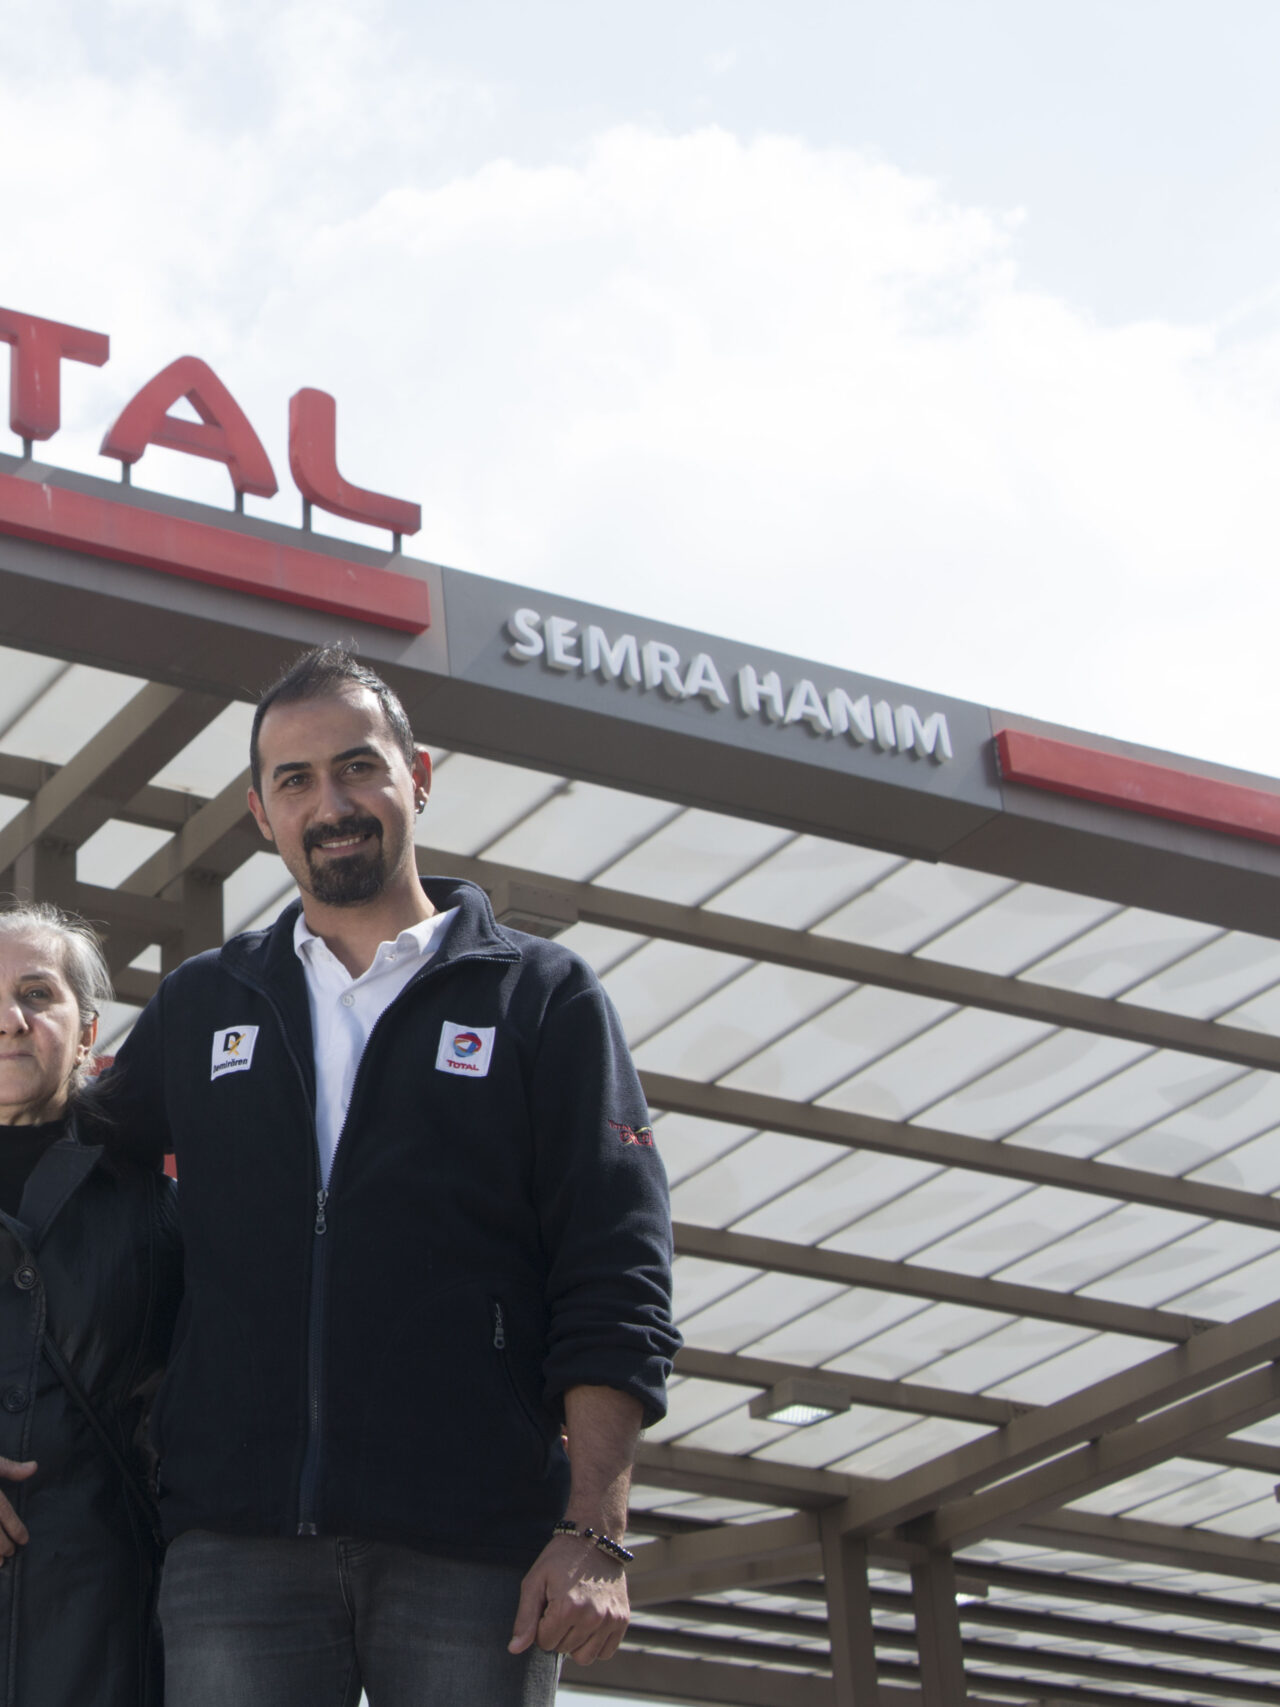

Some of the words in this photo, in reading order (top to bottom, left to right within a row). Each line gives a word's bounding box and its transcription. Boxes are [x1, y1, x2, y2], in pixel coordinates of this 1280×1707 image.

[507, 608, 730, 708] SEMRA
[738, 664, 953, 763] HANIM
[446, 1059, 480, 1071] TOTAL
